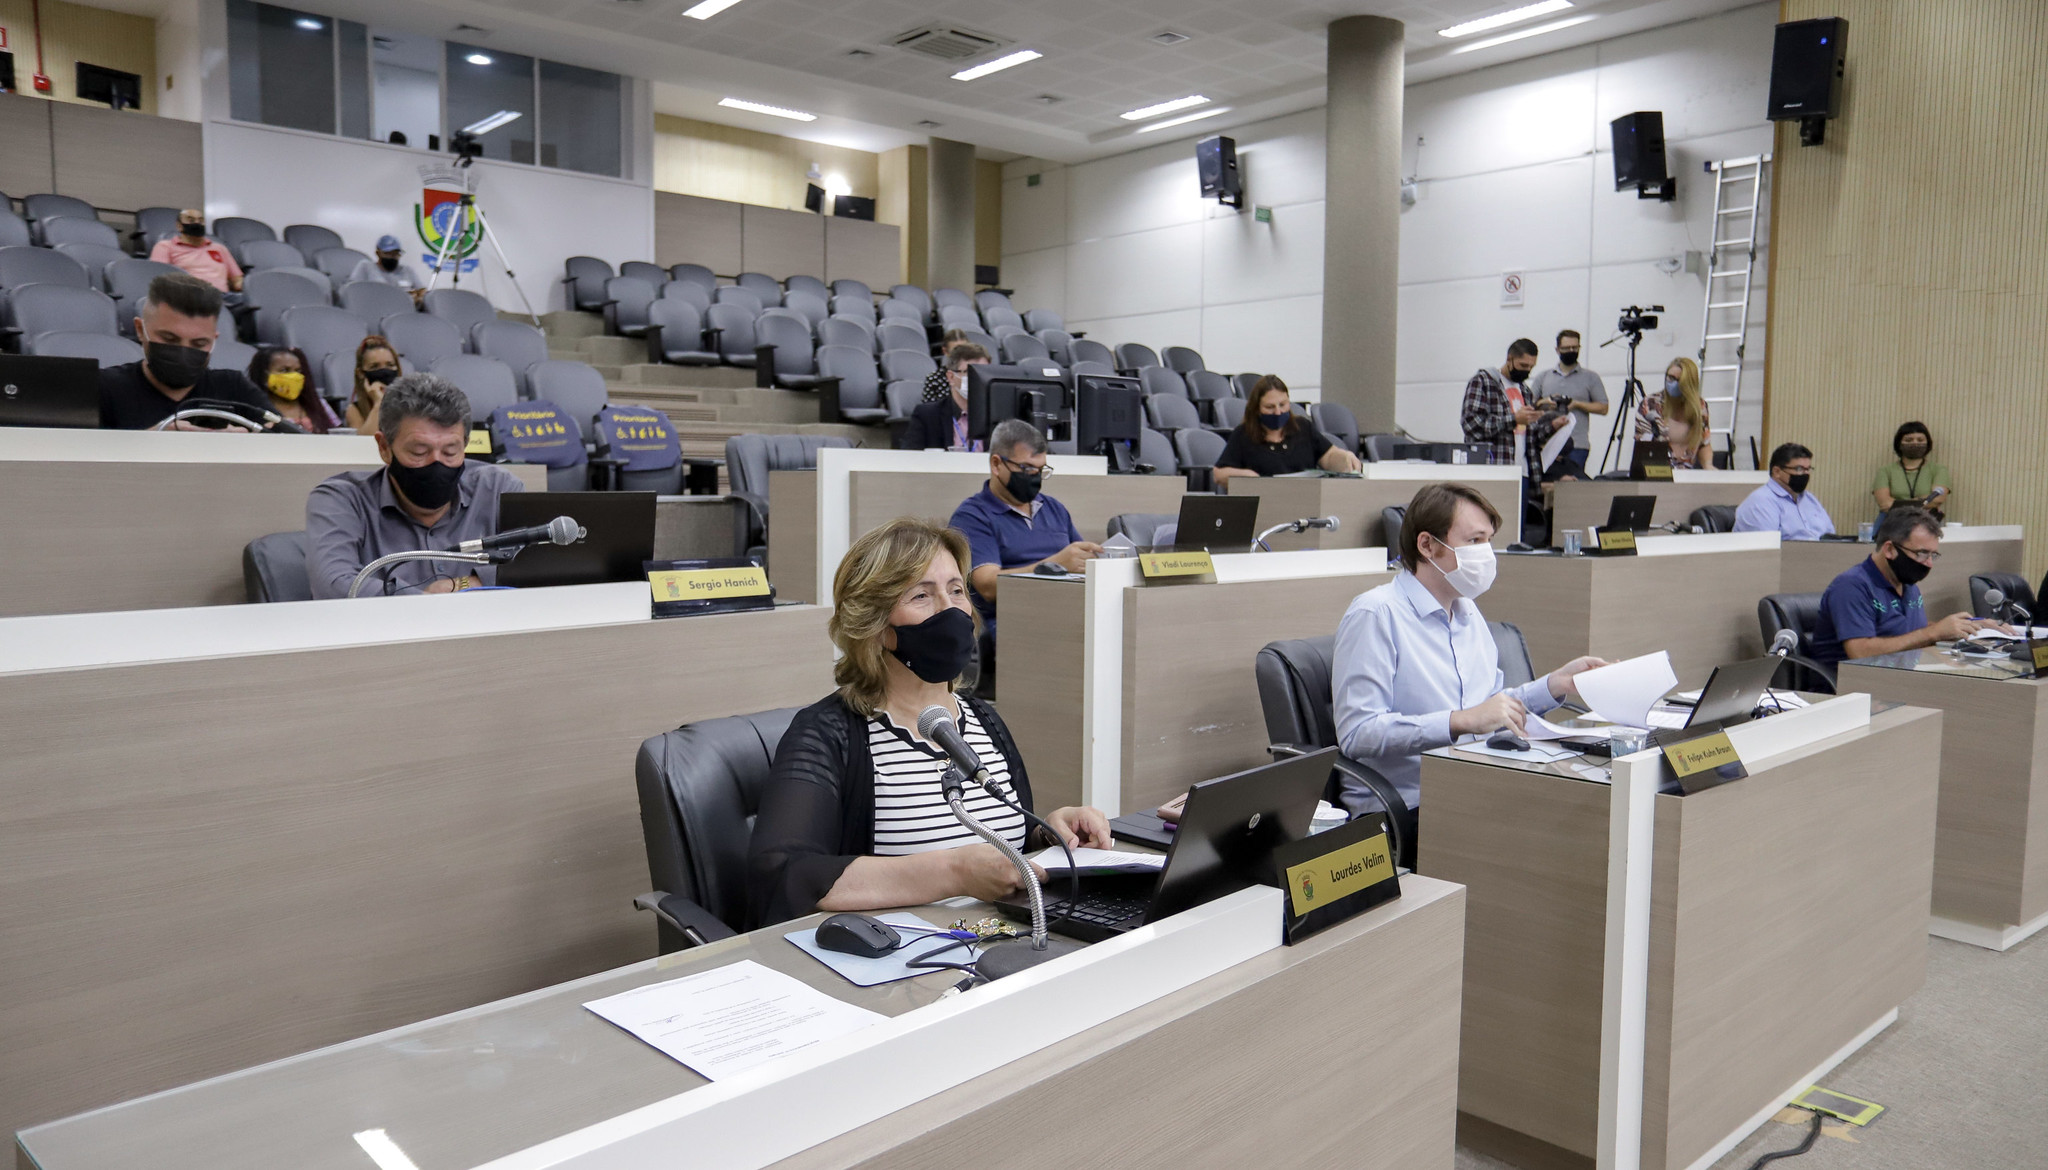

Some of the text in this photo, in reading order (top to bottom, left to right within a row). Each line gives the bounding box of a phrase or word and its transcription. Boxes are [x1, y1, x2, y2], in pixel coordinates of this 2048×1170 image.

[688, 577, 759, 591] Sergio Hanich
[1687, 752, 1703, 763] Felipe
[1703, 749, 1716, 759] Kuhn
[1330, 862, 1363, 883] Lourdes
[1362, 852, 1385, 870] Valim
